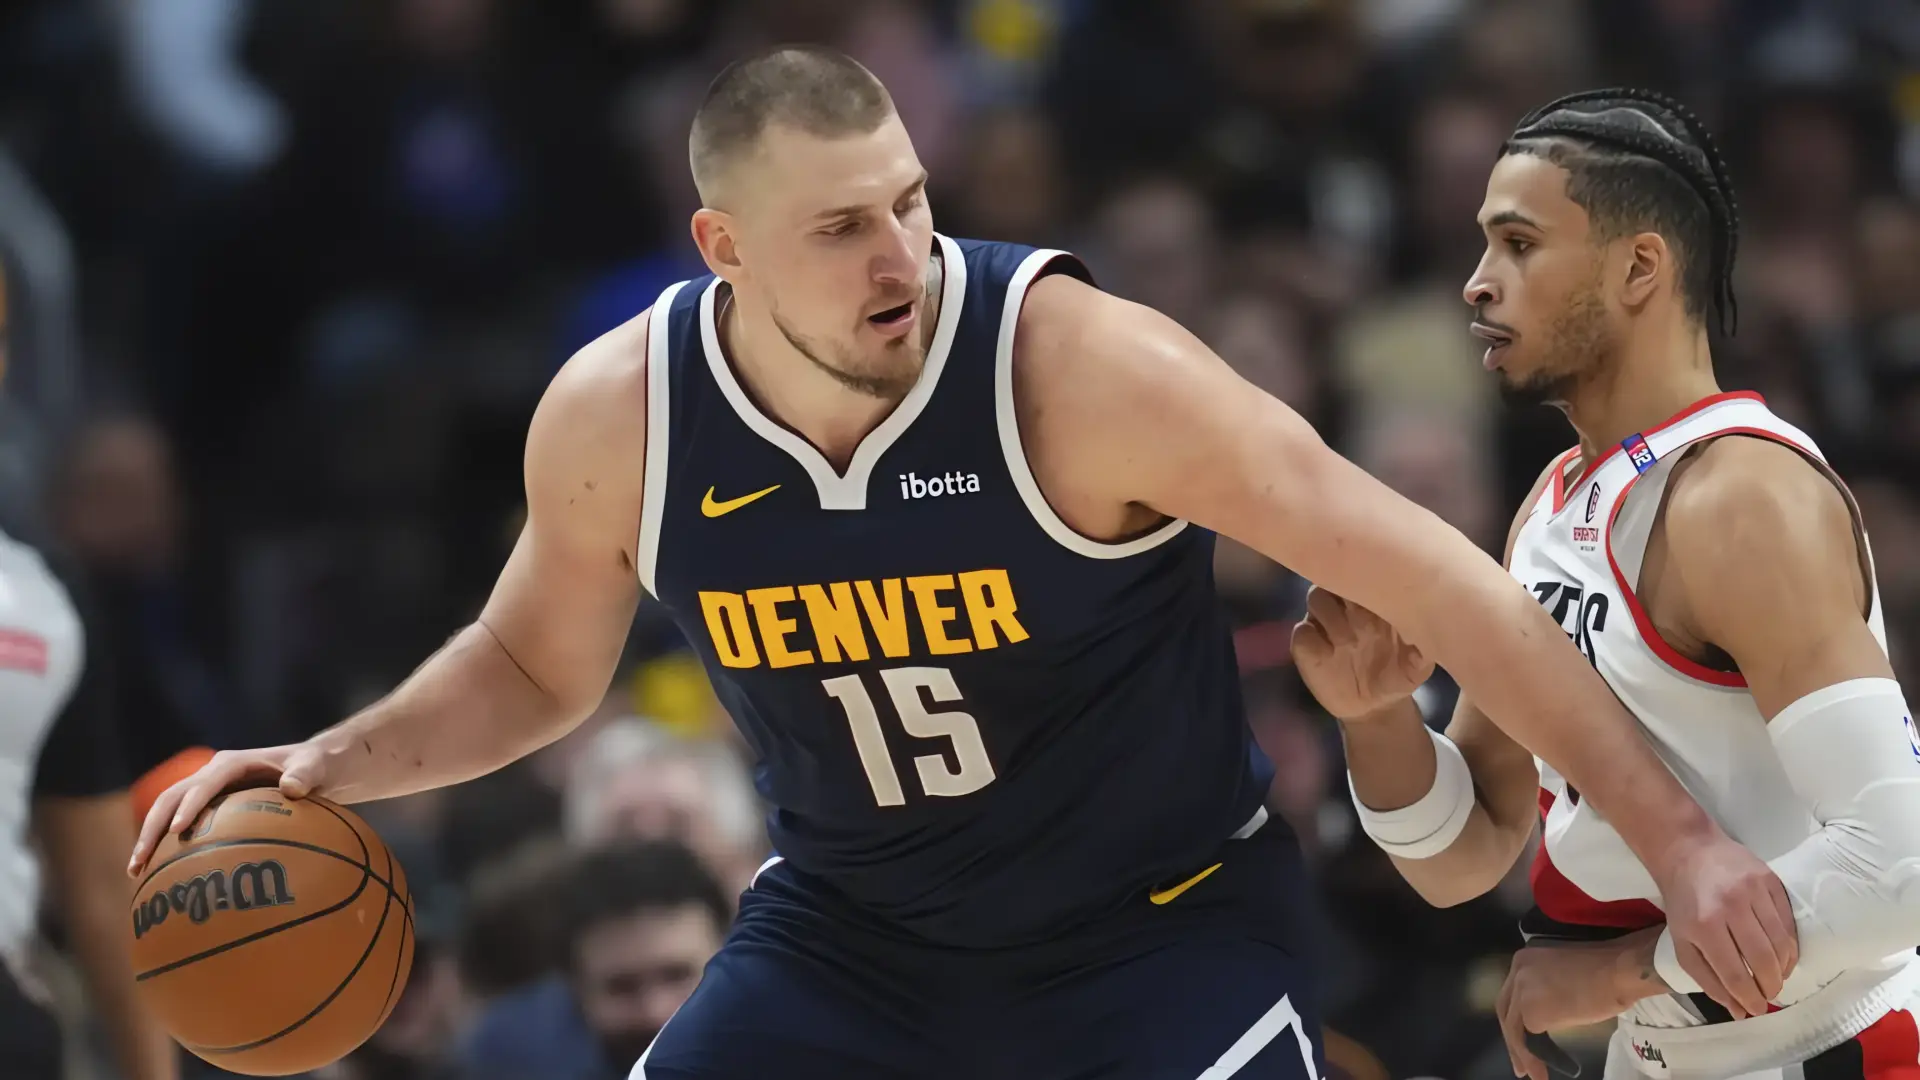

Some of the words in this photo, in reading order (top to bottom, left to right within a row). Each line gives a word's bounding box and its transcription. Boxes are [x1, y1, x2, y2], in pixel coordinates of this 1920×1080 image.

[899, 471, 981, 500] ibotta
[1632, 447, 1653, 468] 32
[698, 569, 1030, 669] DENVER
[821, 667, 997, 807] 15
[132, 859, 296, 939] Wilson
